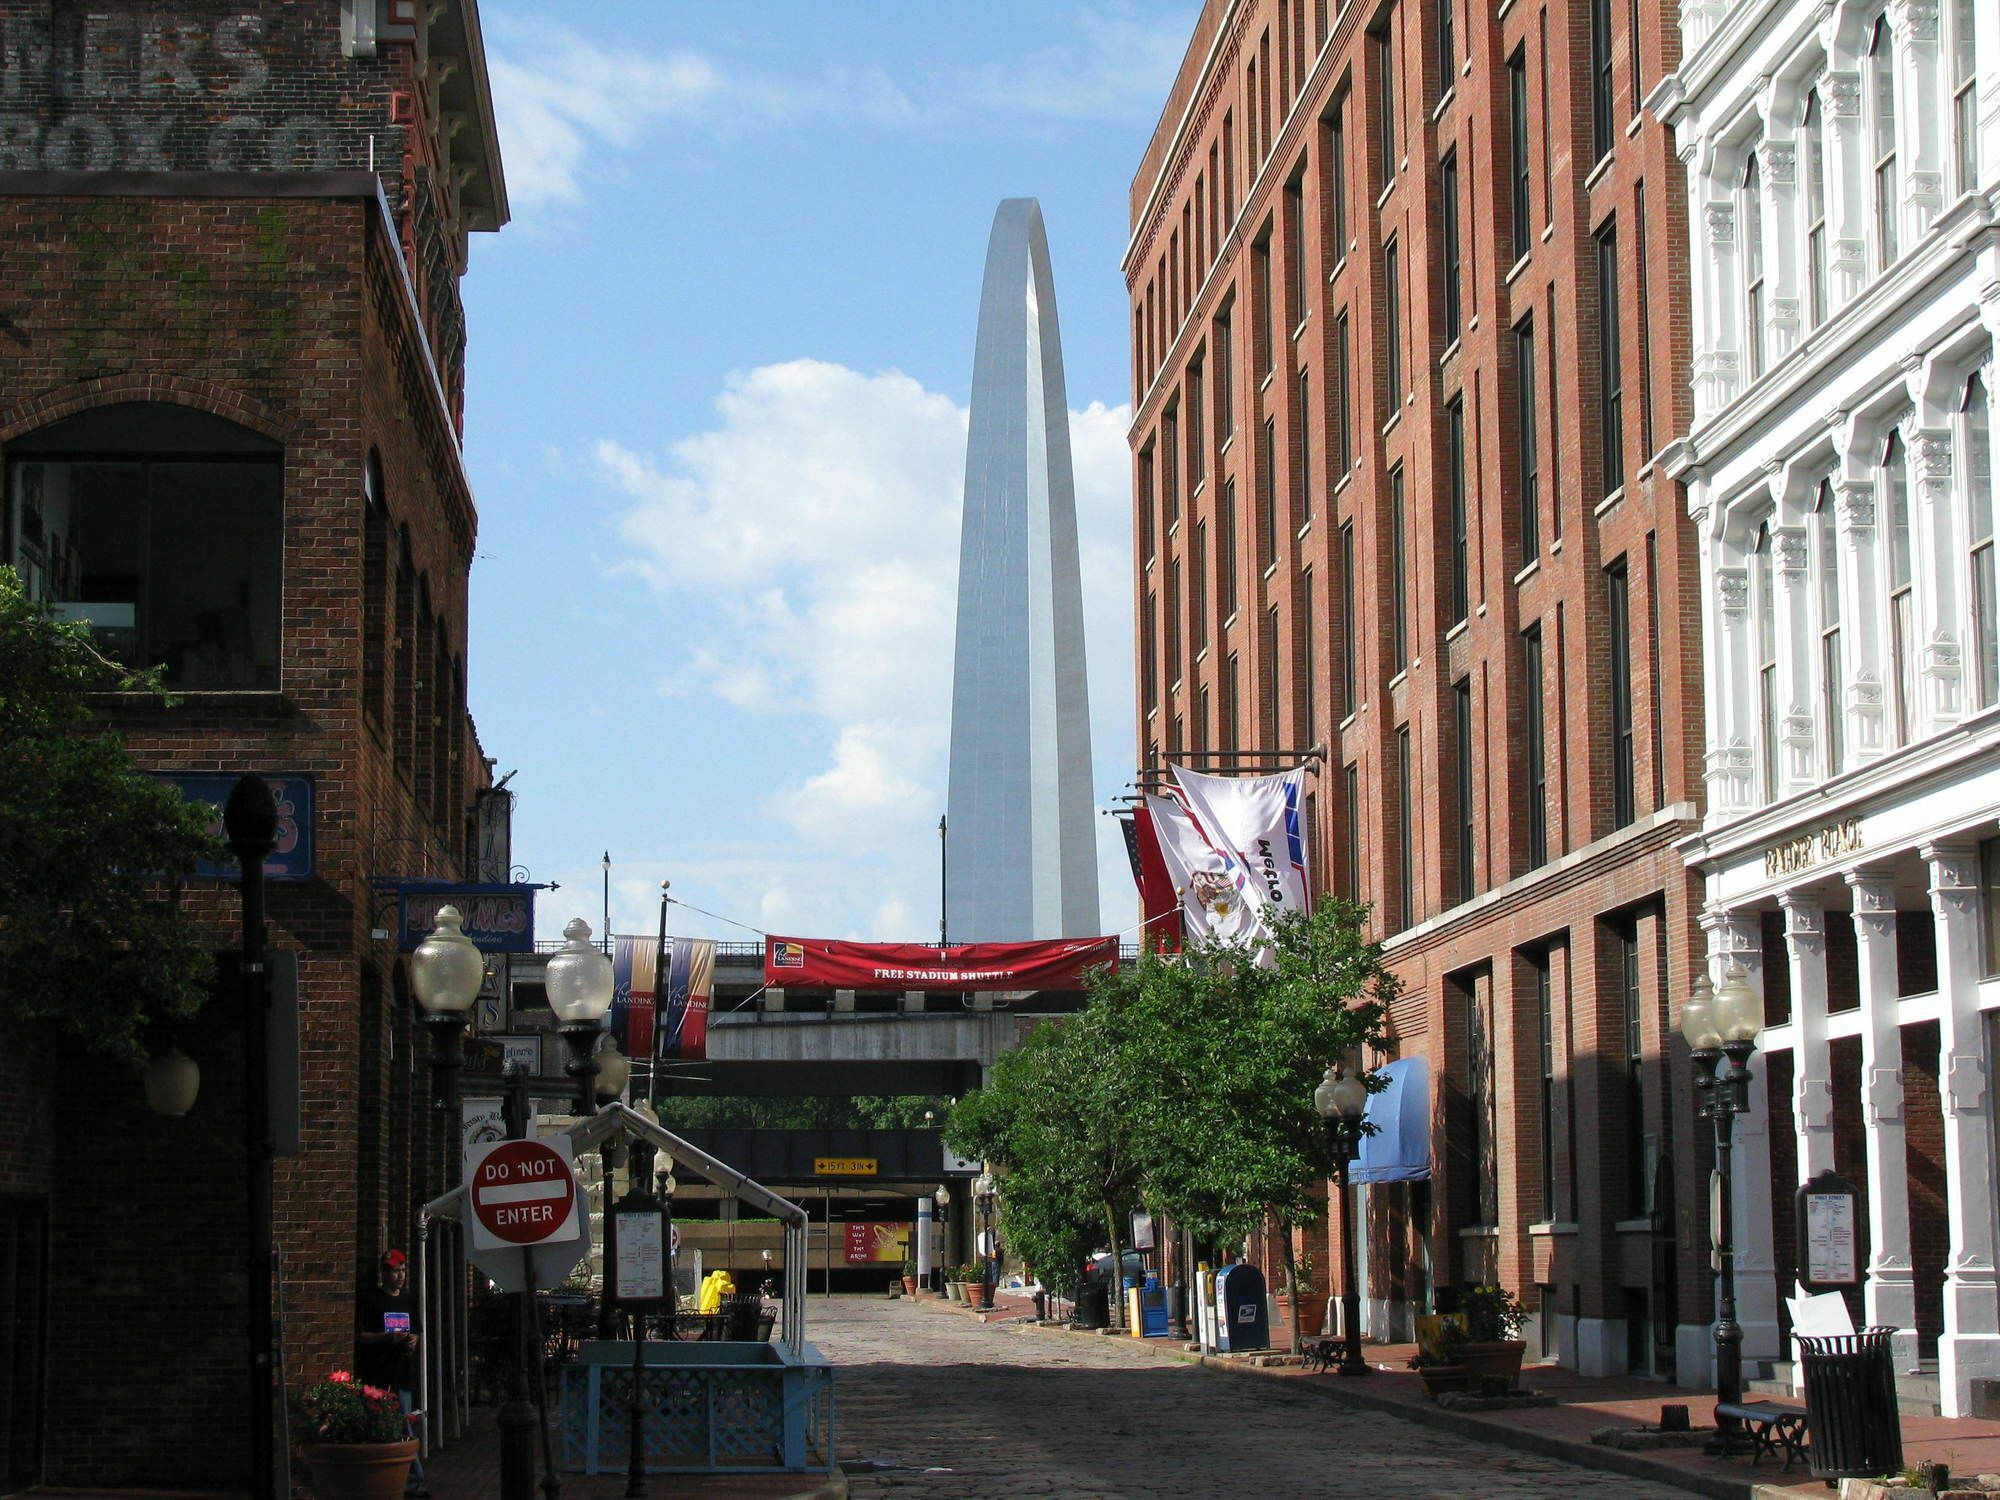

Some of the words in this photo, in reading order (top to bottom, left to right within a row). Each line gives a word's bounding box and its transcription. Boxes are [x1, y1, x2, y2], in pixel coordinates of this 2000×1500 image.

[1257, 839, 1283, 902] Metro
[874, 968, 904, 979] FREE
[906, 970, 958, 980] STADIUM
[961, 971, 1014, 980] SHUTTLE
[486, 1163, 509, 1180] DO
[520, 1159, 556, 1177] NOT
[496, 1205, 554, 1225] ENTER
